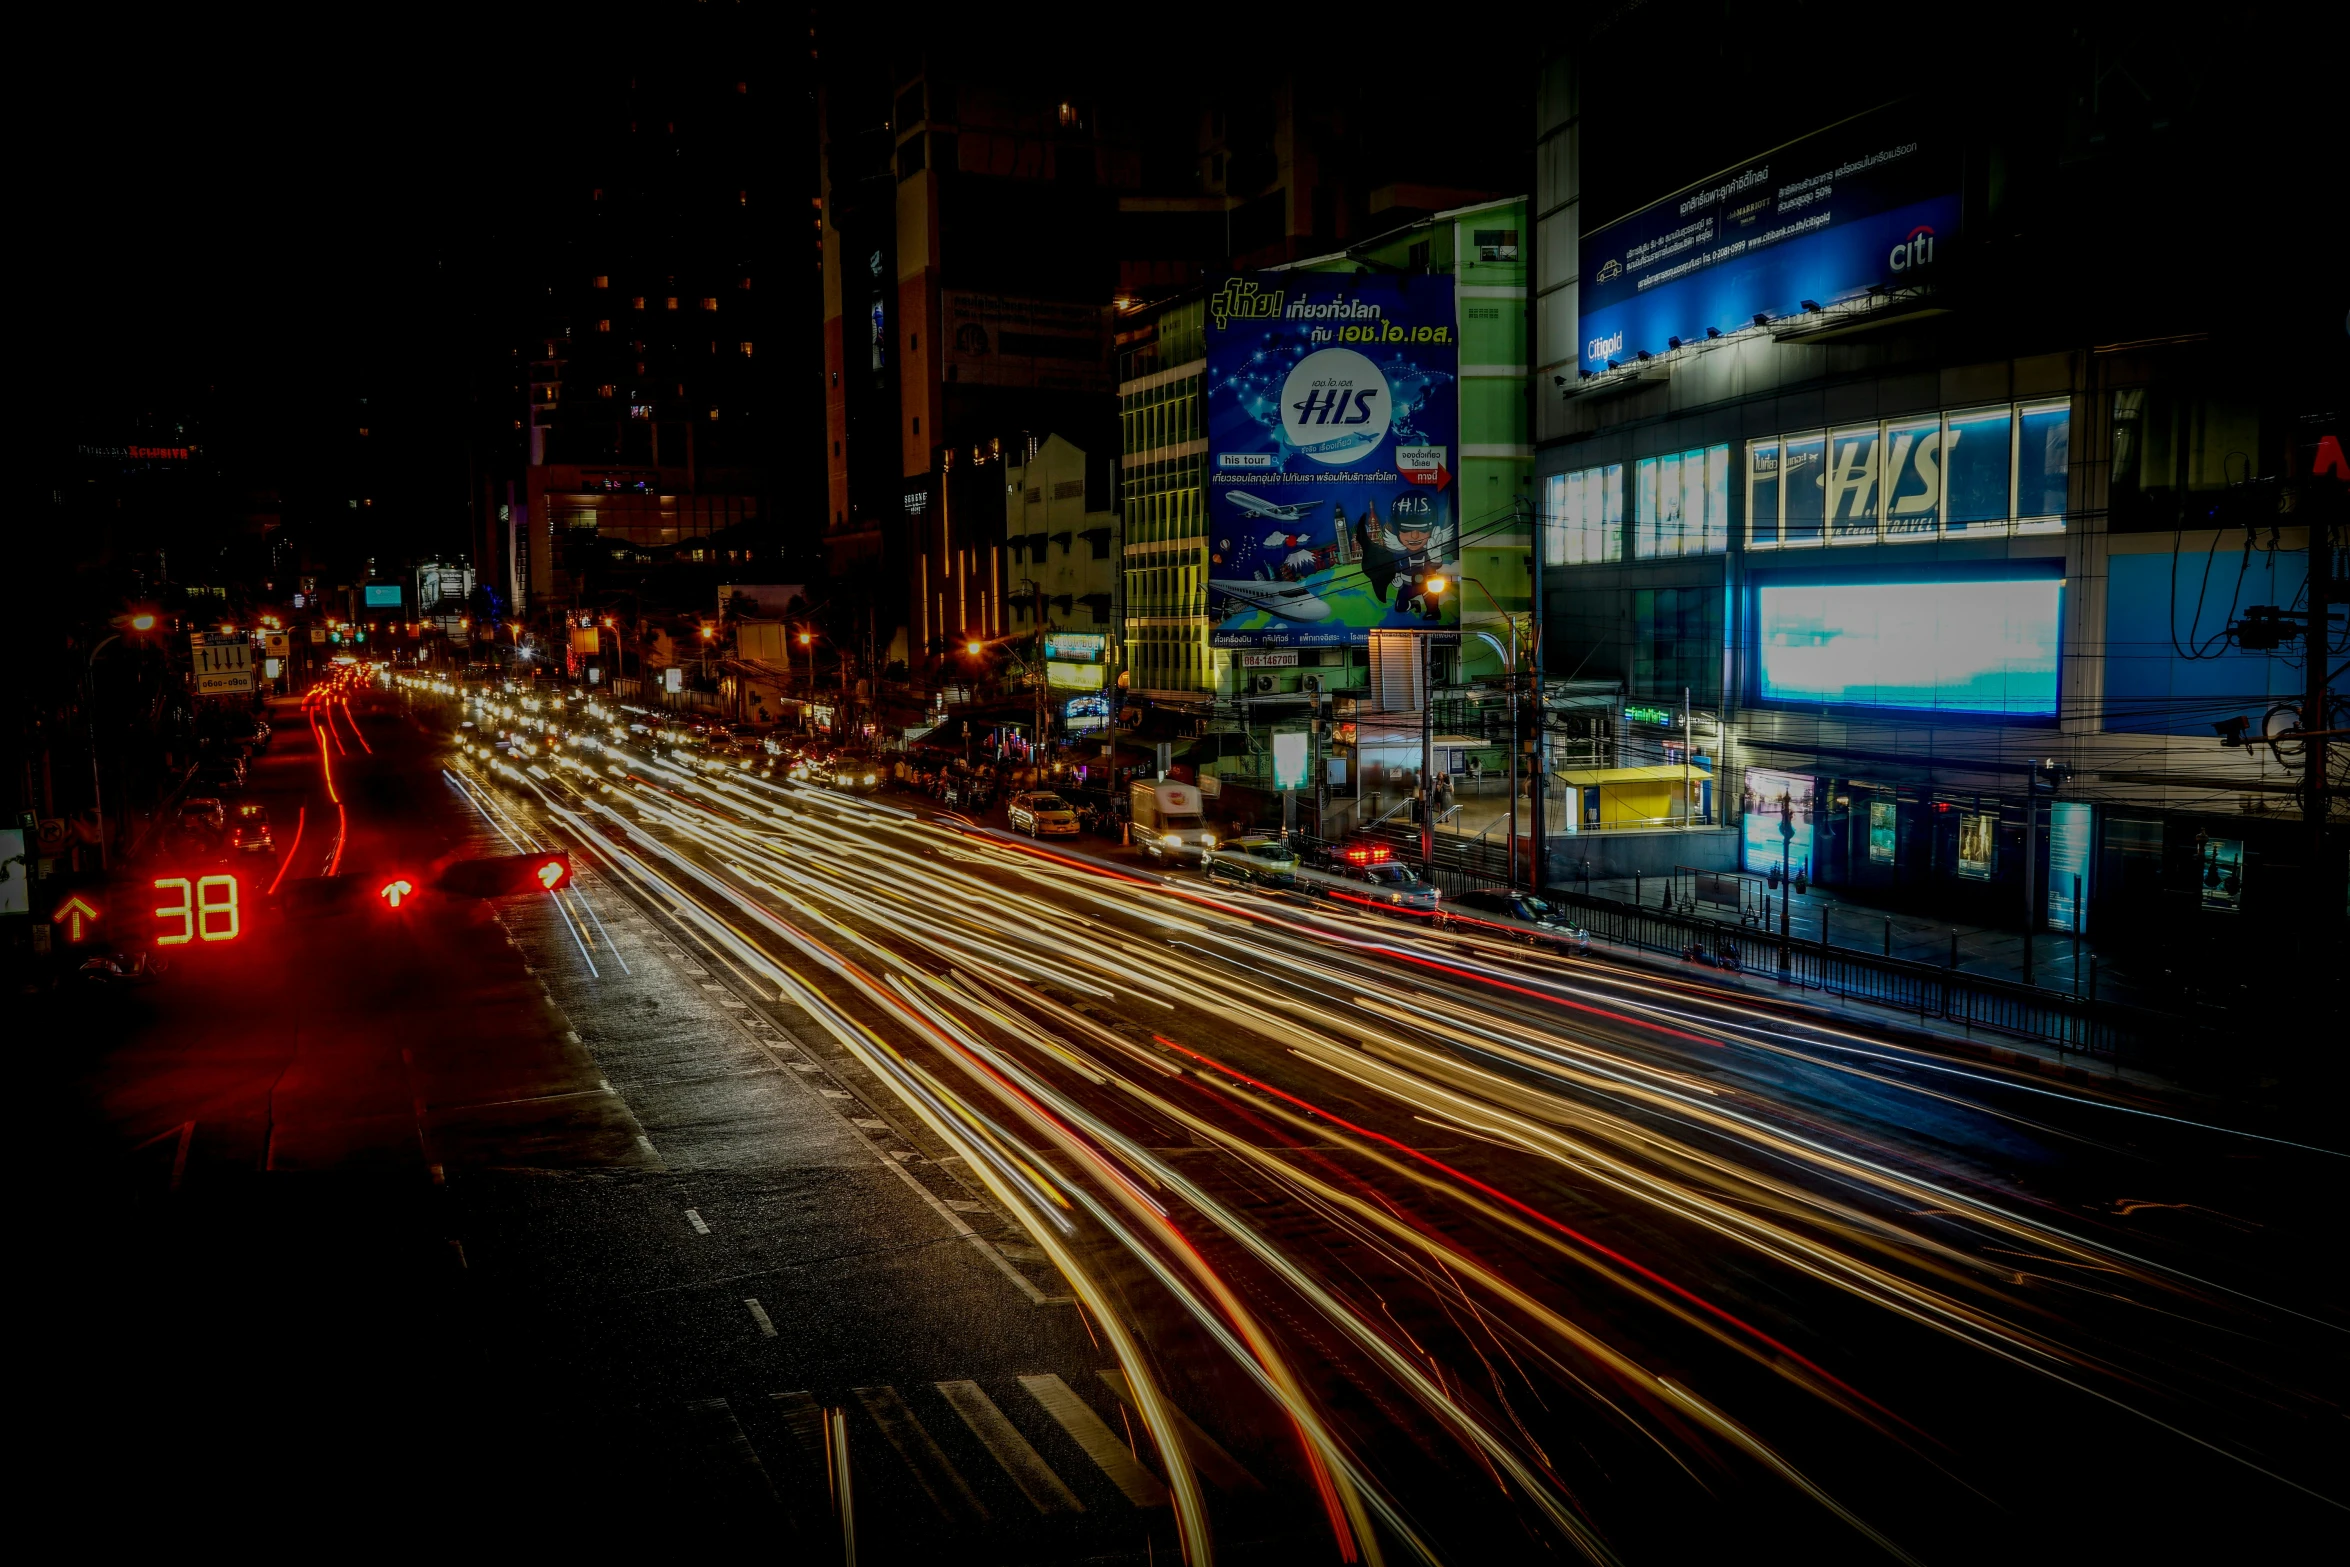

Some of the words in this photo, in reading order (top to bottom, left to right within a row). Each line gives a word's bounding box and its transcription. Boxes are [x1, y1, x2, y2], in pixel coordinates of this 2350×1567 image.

[1815, 185, 1832, 198] 50%
[1748, 211, 1831, 249] www.citibank.co.th/citigold
[1890, 232, 1934, 270] citi
[1286, 293, 1381, 320] เที่ยวทั่วโลก
[1311, 326, 1332, 342] กับ
[1338, 319, 1453, 343] เอช.ไอ.เอส.
[1588, 330, 1622, 361] Citigold
[1225, 456, 1239, 464] his
[1417, 470, 1438, 481] ทางนี้
[904, 492, 927, 503] SERENE
[1884, 516, 1933, 533] TRAVEL
[203, 677, 248, 688] 0600-0900
[1631, 706, 1661, 723] FamilyMart
[154, 874, 239, 945] 38
